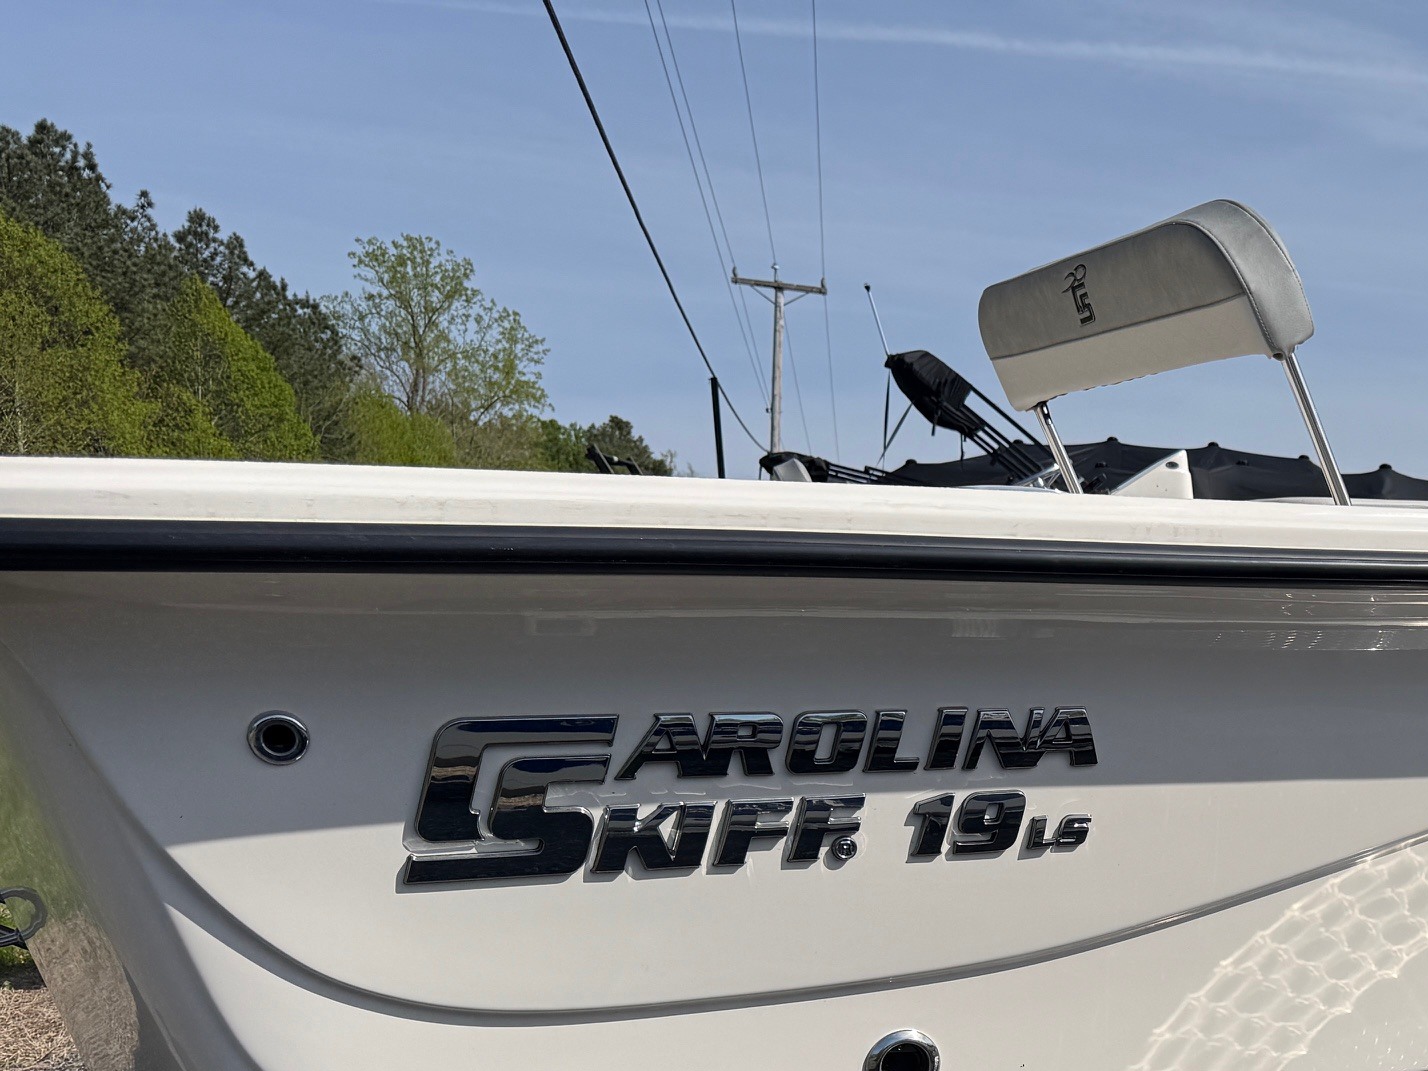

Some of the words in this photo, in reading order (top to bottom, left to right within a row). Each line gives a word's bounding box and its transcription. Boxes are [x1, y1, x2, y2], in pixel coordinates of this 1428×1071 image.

[413, 705, 1099, 844] CAROLINA
[912, 789, 1028, 857] 19
[1026, 813, 1092, 850] LS
